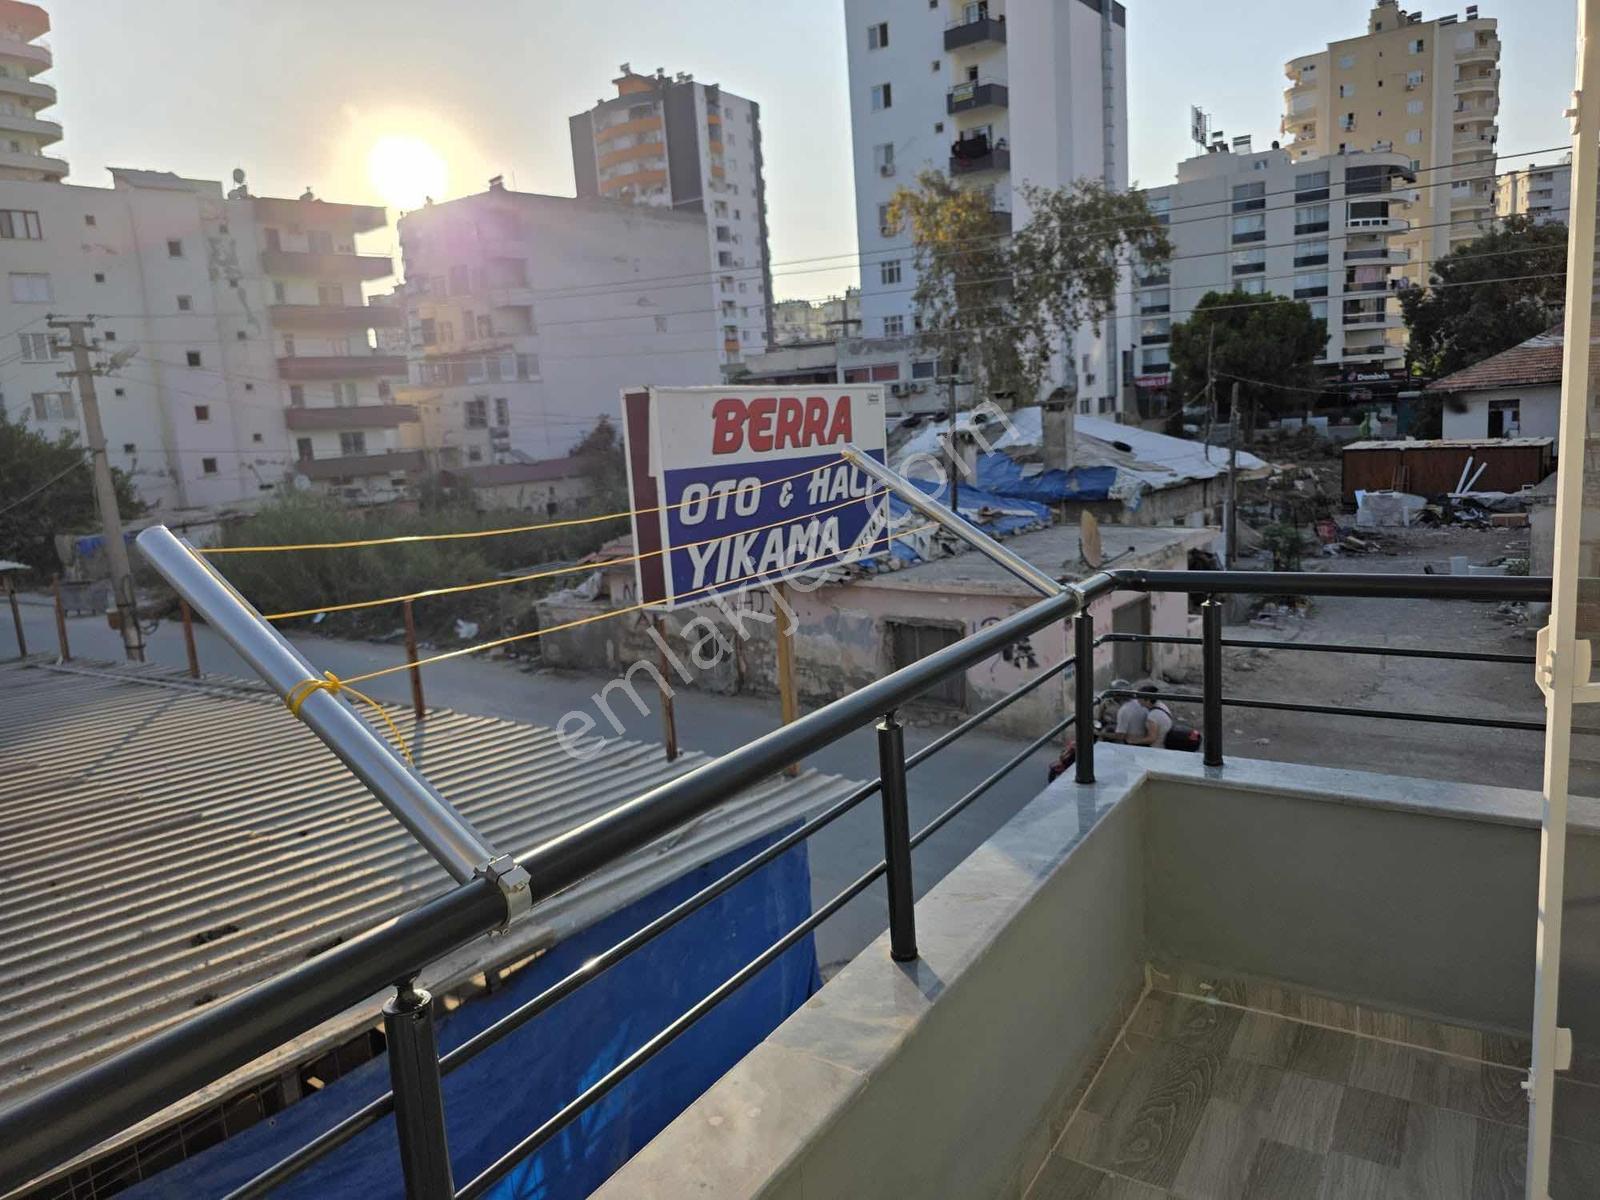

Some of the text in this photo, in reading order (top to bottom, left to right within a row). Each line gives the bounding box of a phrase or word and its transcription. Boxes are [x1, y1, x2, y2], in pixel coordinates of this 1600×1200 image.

[711, 395, 853, 455] BERRA
[679, 477, 762, 526] OTO
[778, 481, 795, 509] &
[687, 515, 841, 590] YIKAMA
